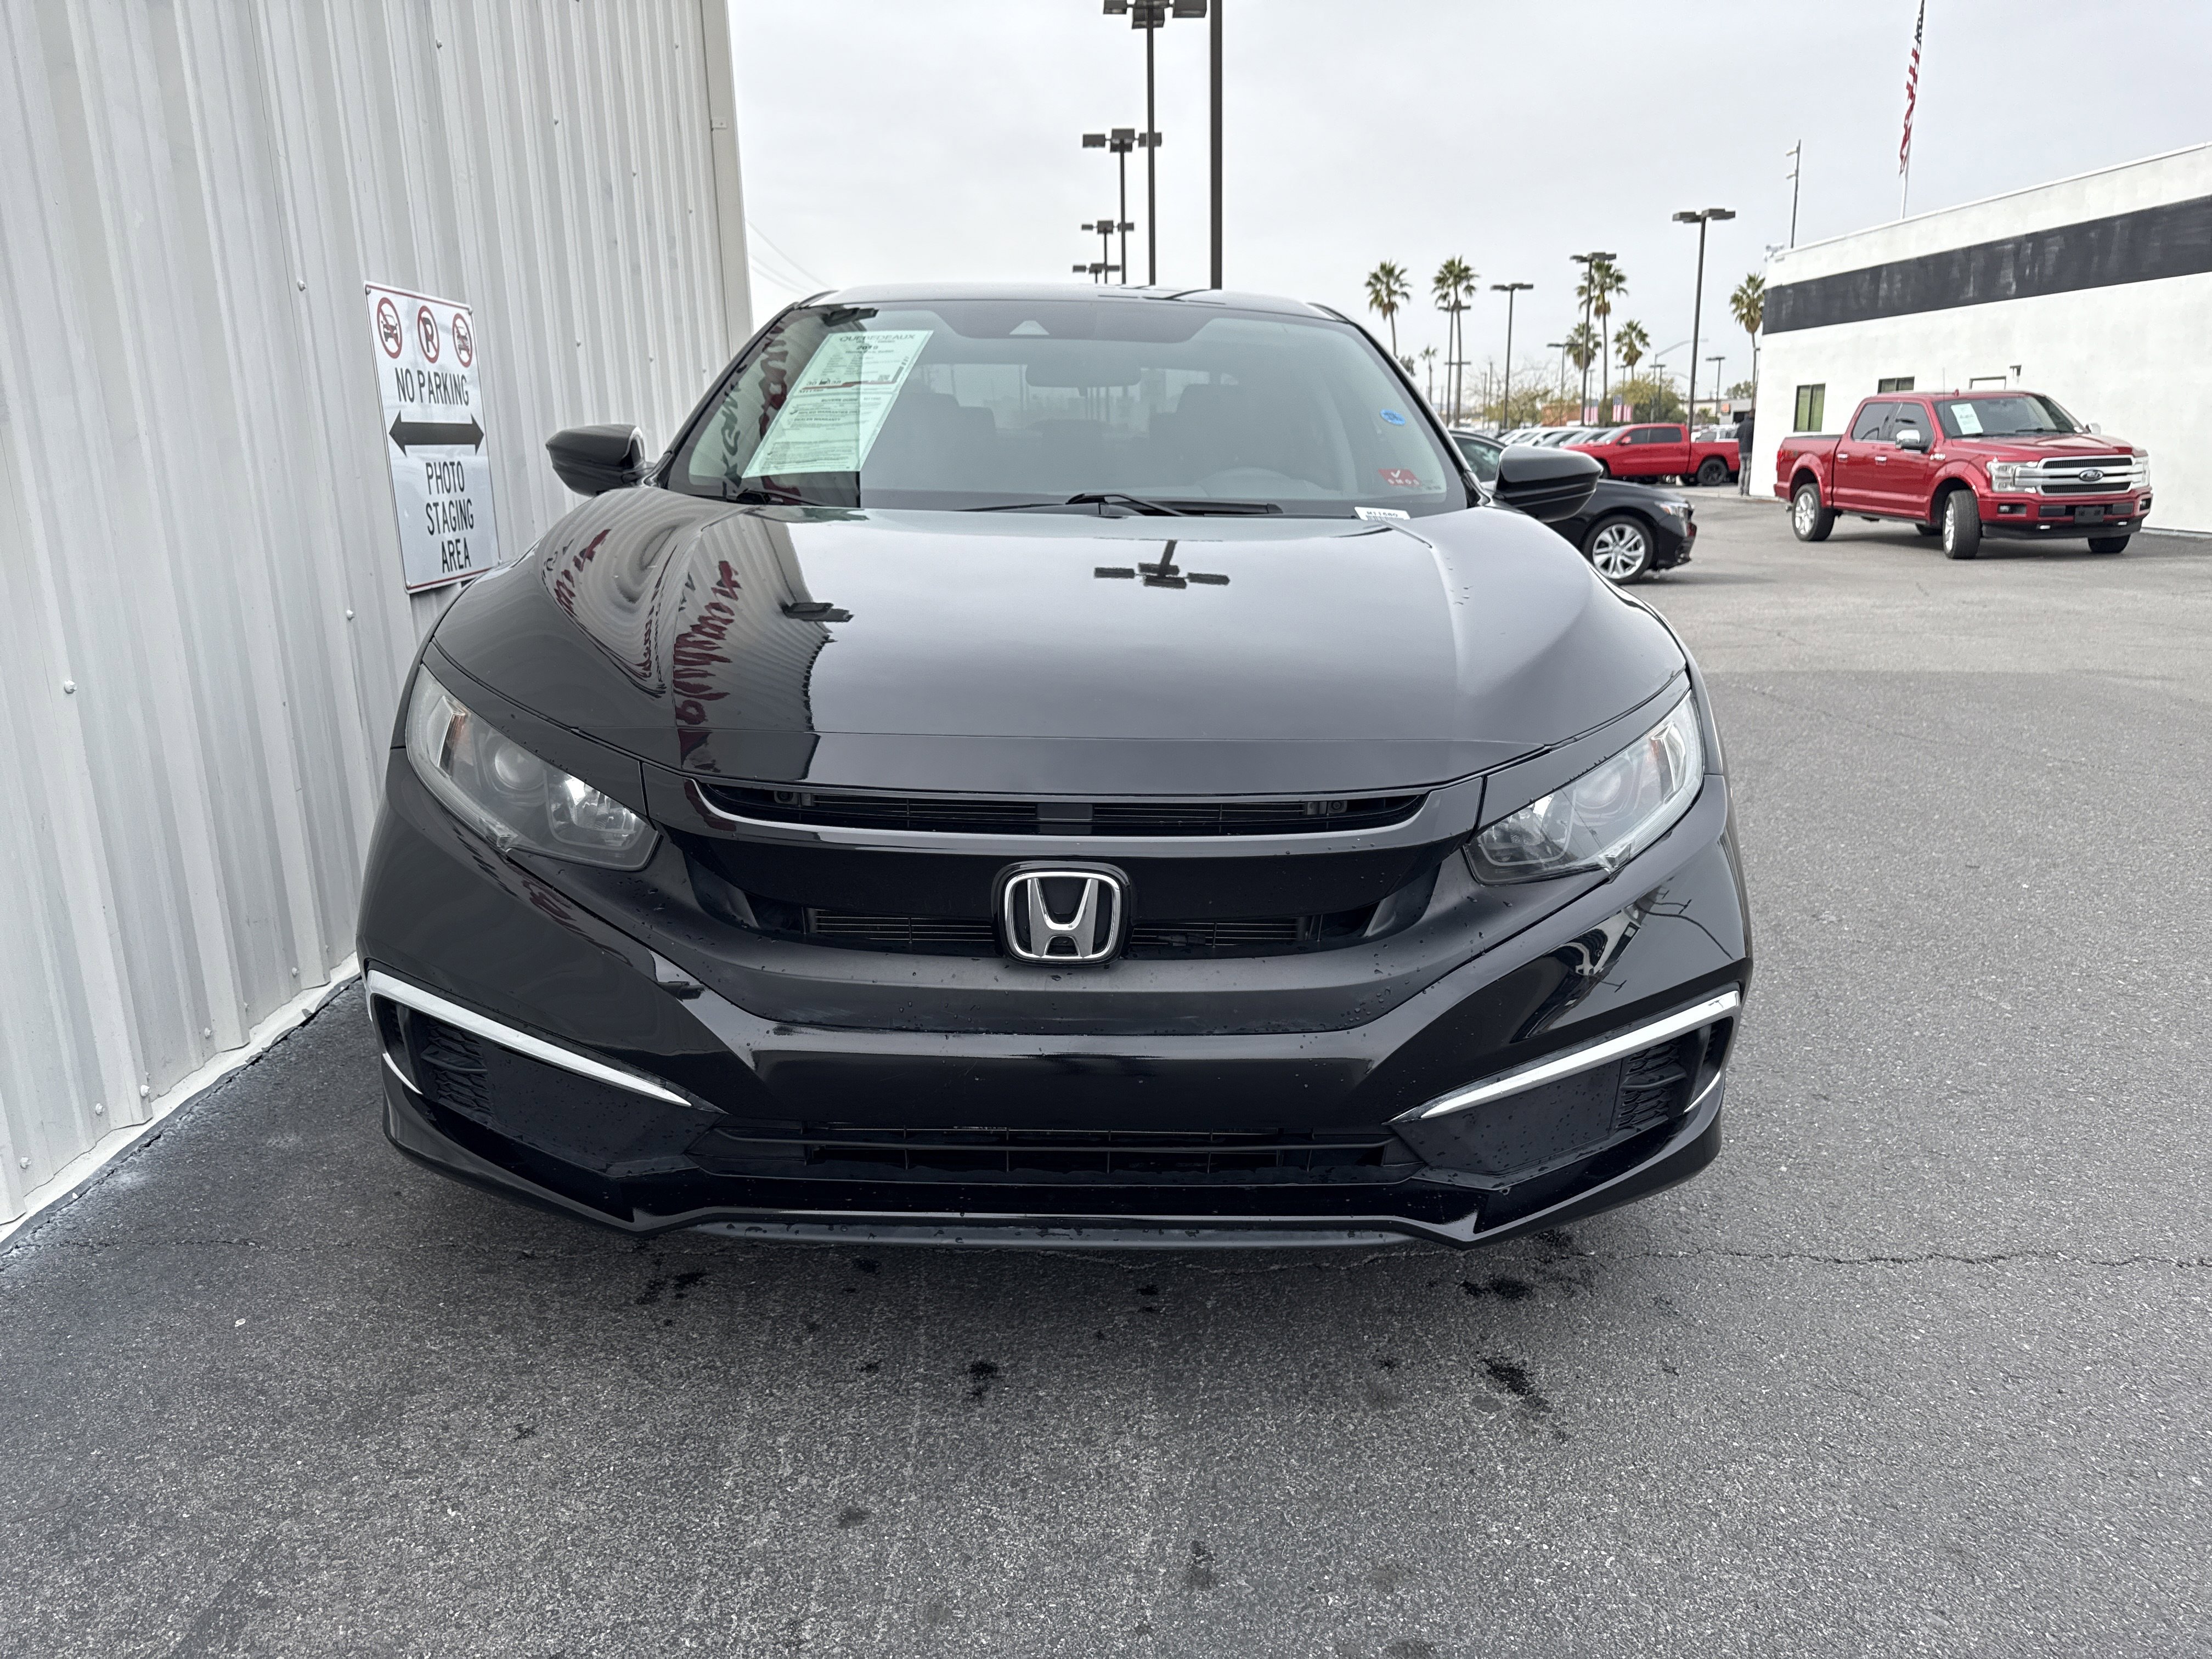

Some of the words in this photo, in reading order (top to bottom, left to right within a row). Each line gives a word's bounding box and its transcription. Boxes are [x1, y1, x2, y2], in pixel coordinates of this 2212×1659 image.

[395, 367, 415, 403] NO
[417, 370, 469, 406] PARKING
[426, 461, 465, 495] PHOTO
[426, 498, 474, 535] STAGING
[441, 537, 472, 573] AREA
